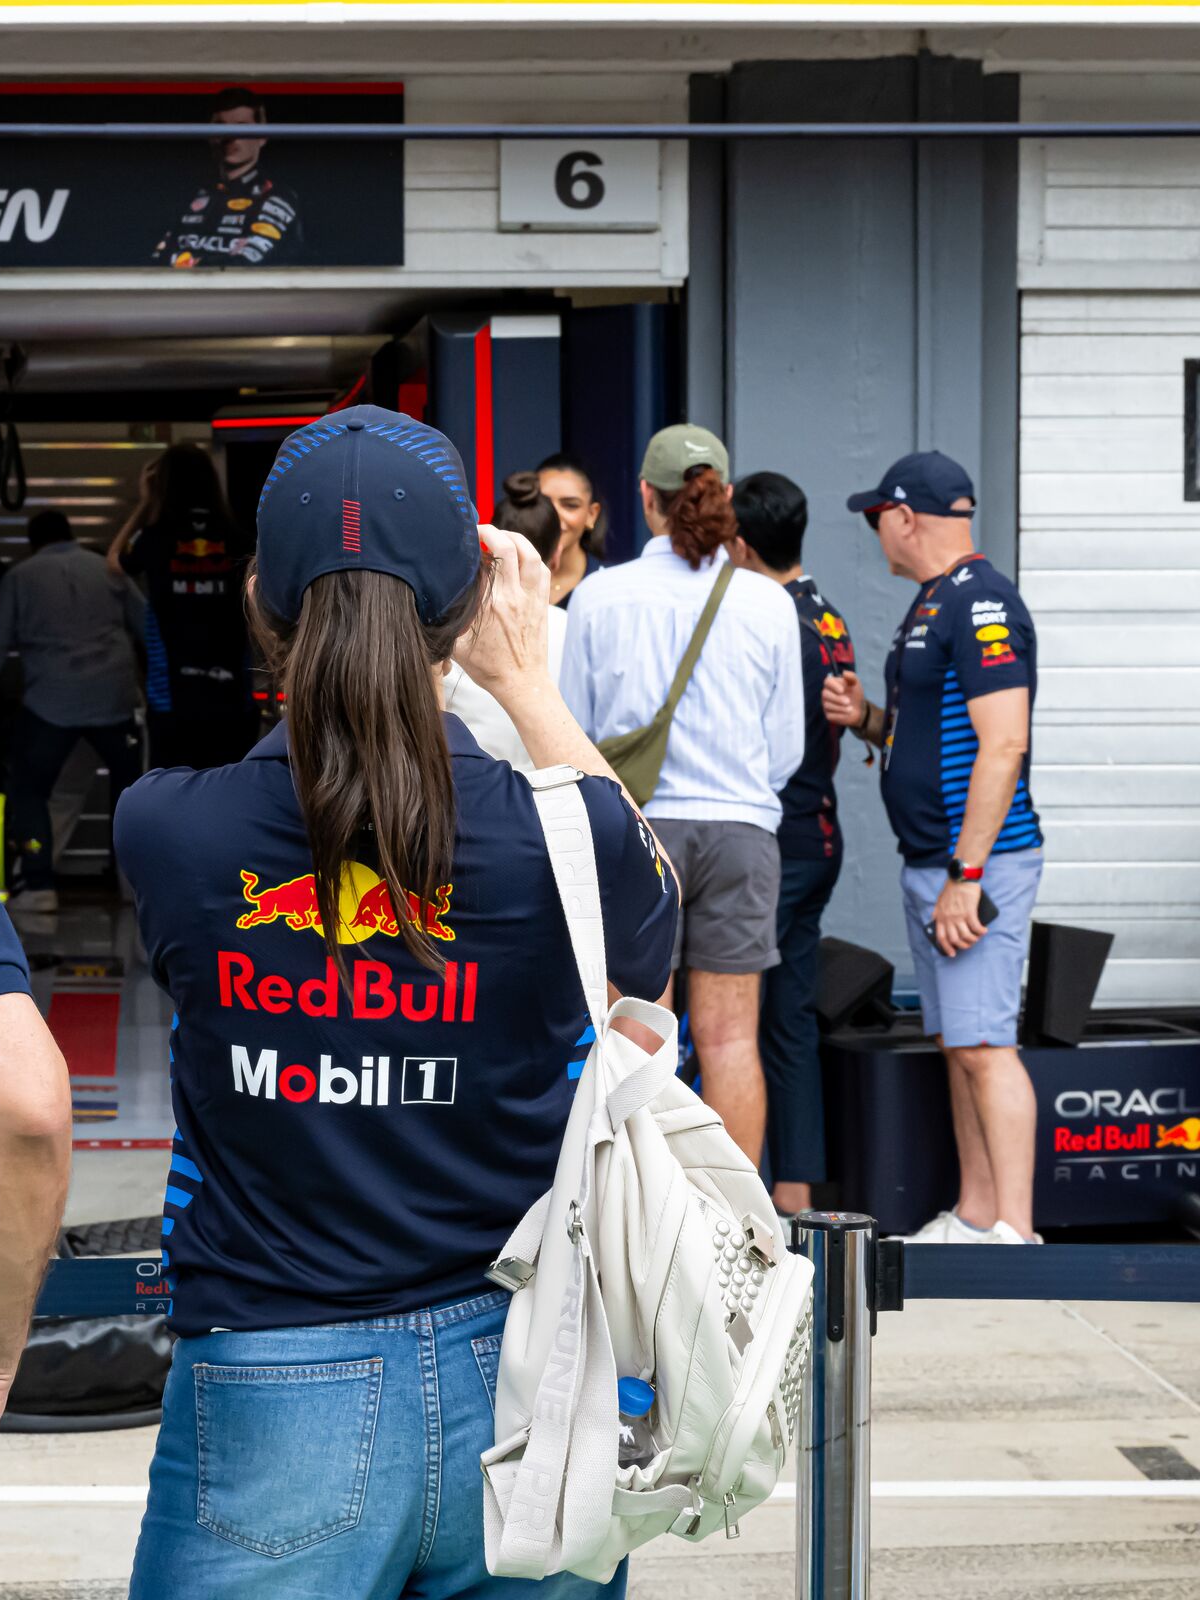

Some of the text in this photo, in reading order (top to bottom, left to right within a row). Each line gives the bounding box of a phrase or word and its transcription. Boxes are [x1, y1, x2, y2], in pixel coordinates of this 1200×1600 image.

[554, 151, 605, 209] 6
[217, 951, 478, 1023] Red Bull
[231, 1045, 389, 1106] Mobil
[1054, 1088, 1200, 1118] ORACL
[1054, 1123, 1151, 1152] Red Bull
[1054, 1162, 1197, 1182] RACIN
